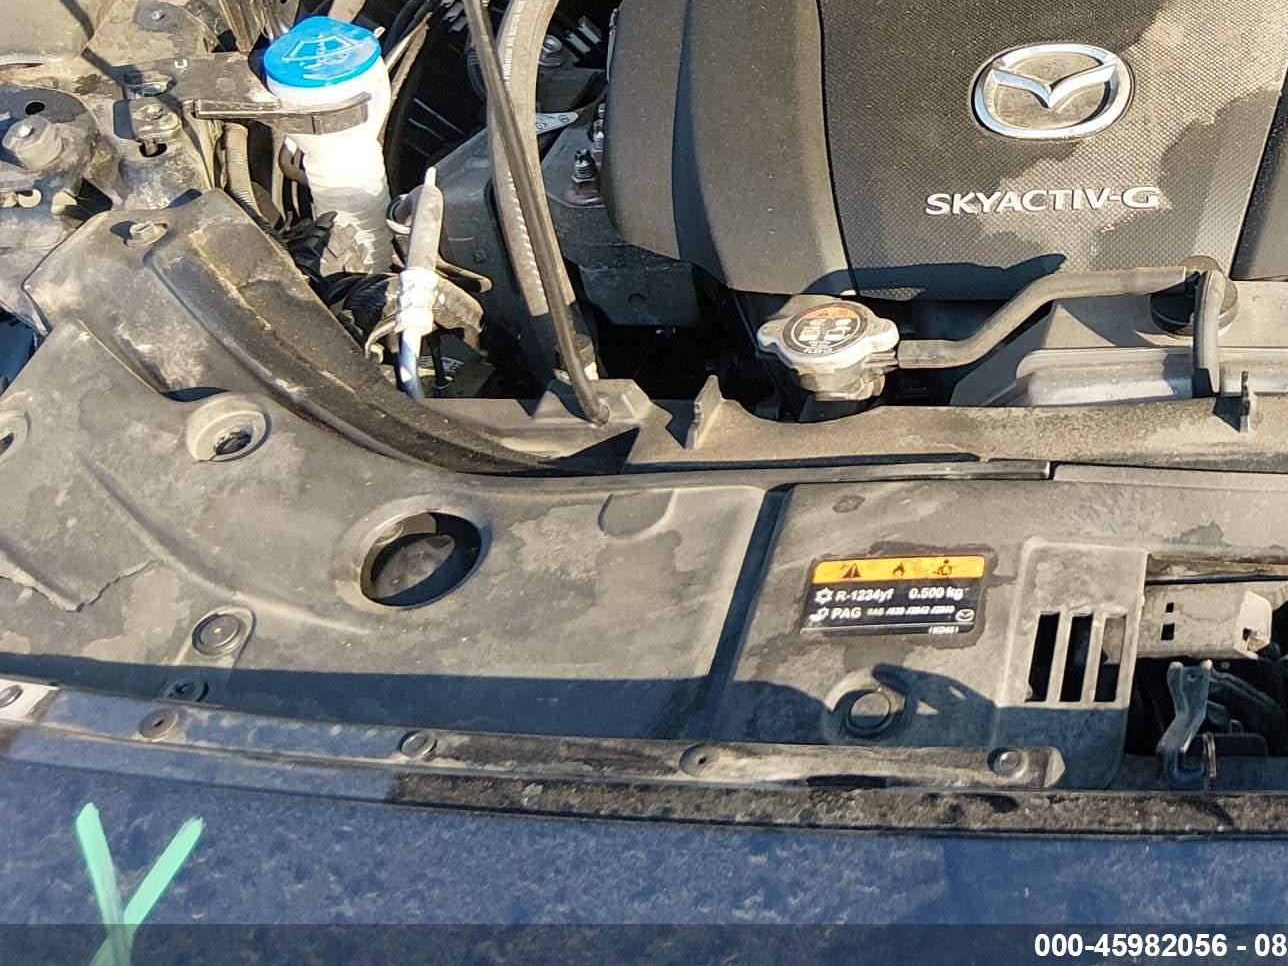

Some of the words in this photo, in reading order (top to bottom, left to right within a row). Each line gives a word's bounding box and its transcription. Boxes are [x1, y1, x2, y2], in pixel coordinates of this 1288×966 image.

[925, 186, 1160, 215] SKYACTIV-G
[946, 587, 964, 601] kg
[831, 607, 862, 619] PAG
